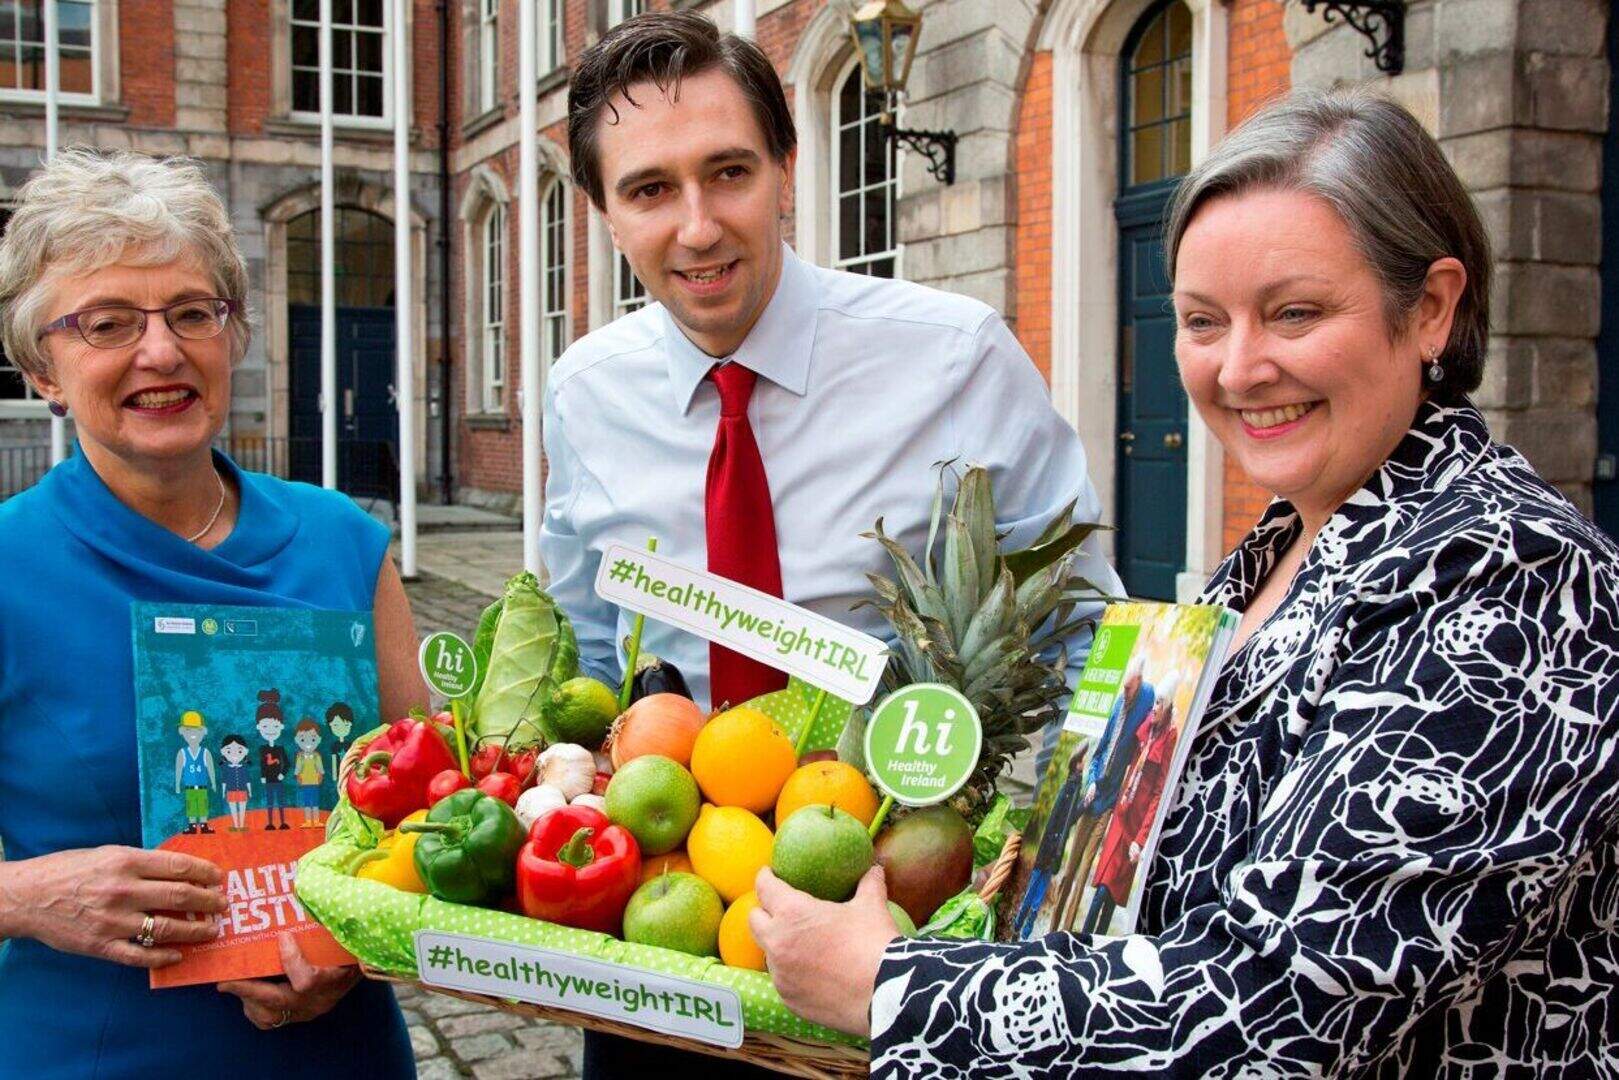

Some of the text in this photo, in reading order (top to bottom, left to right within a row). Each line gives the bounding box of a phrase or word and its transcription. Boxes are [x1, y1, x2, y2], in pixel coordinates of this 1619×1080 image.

[609, 558, 870, 681] #healthyweightIRL
[436, 639, 465, 673] hi
[895, 700, 956, 755] hi
[887, 760, 938, 775] Healthy
[901, 775, 947, 788] Ireland
[428, 945, 735, 1028] #healthyweightIRL
